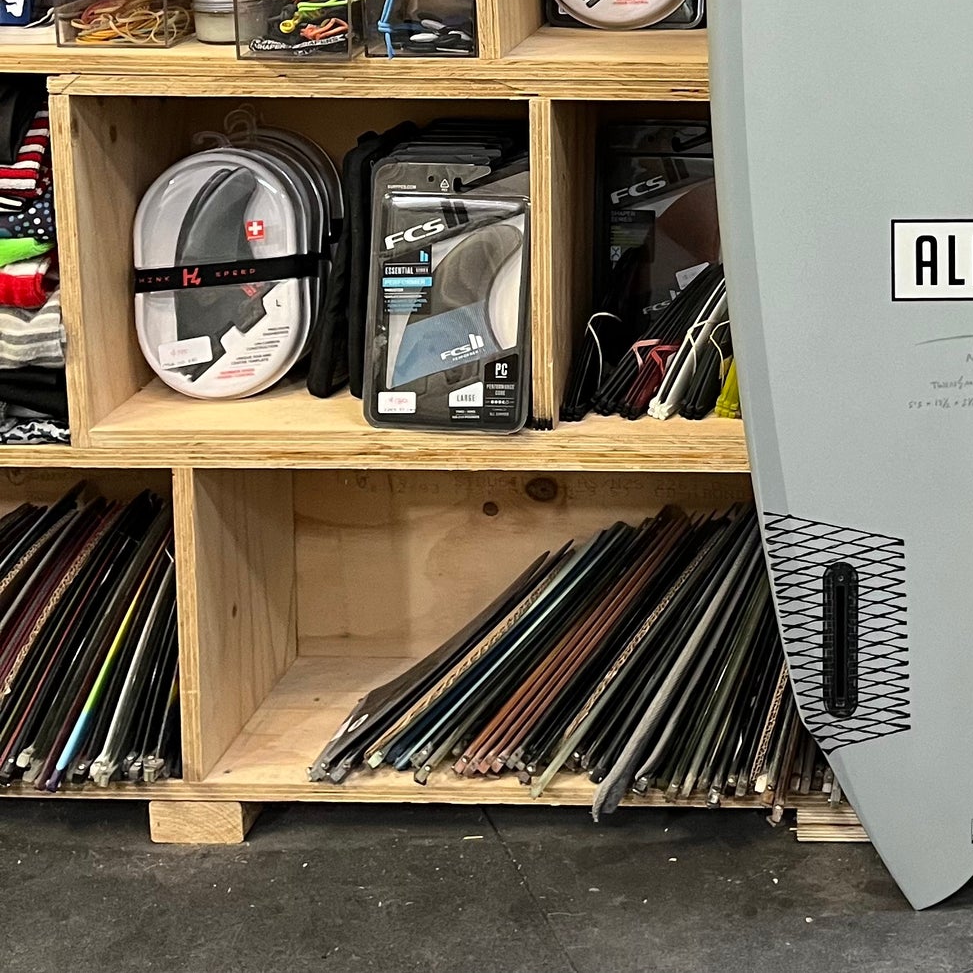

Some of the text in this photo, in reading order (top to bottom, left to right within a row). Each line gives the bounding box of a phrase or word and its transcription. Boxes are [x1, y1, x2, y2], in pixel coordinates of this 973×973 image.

[610, 175, 667, 205] FCS
[384, 218, 445, 250] FCS
[215, 268, 256, 277] SPEED
[384, 266, 414, 275] ESSENTIAL
[138, 276, 170, 284] HINK
[495, 362, 509, 377] PC
[456, 394, 476, 403] LARGE
